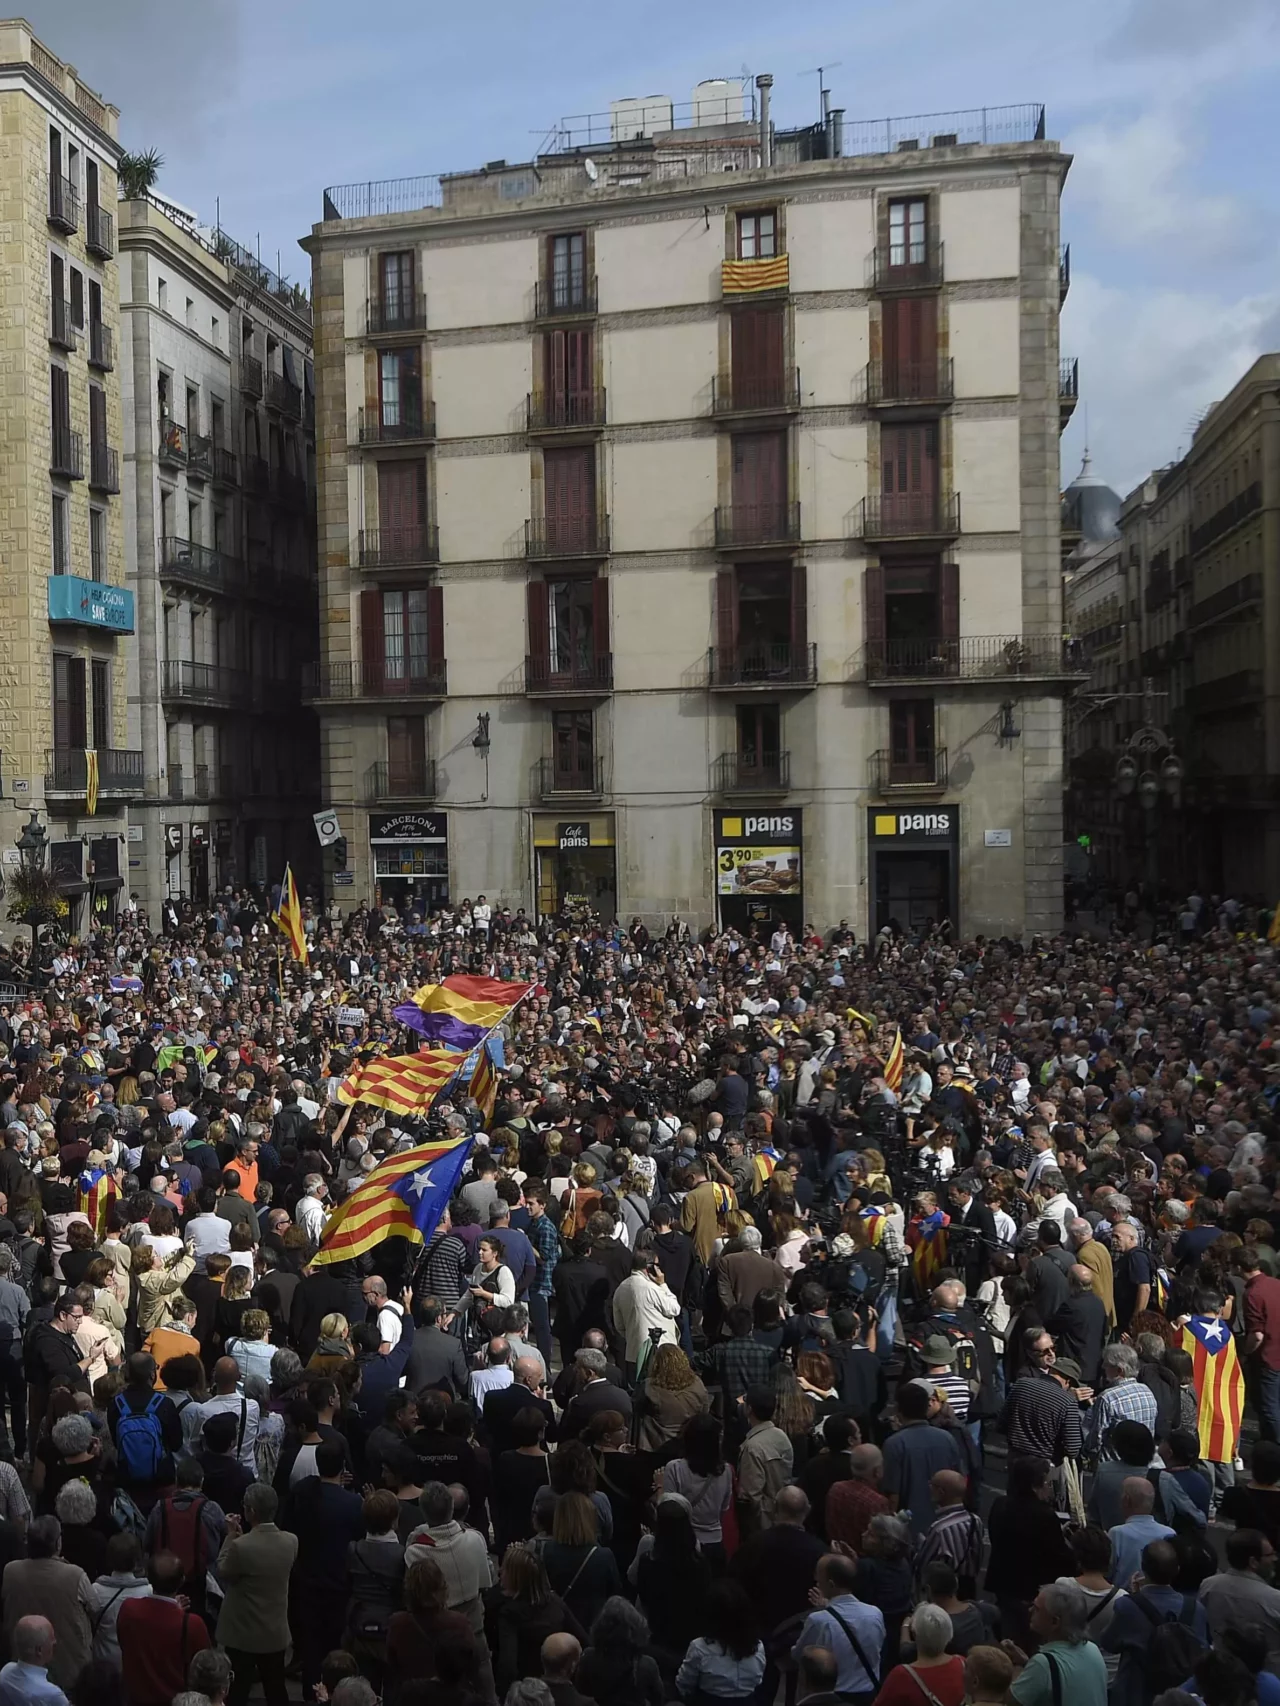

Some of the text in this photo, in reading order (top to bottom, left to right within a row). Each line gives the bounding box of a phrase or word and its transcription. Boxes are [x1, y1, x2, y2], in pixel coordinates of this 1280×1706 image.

[380, 815, 437, 835] BARCELONA
[745, 816, 793, 837] pans
[899, 814, 950, 835] pans
[560, 837, 588, 849] pans
[417, 1453, 458, 1462] Tipographica
